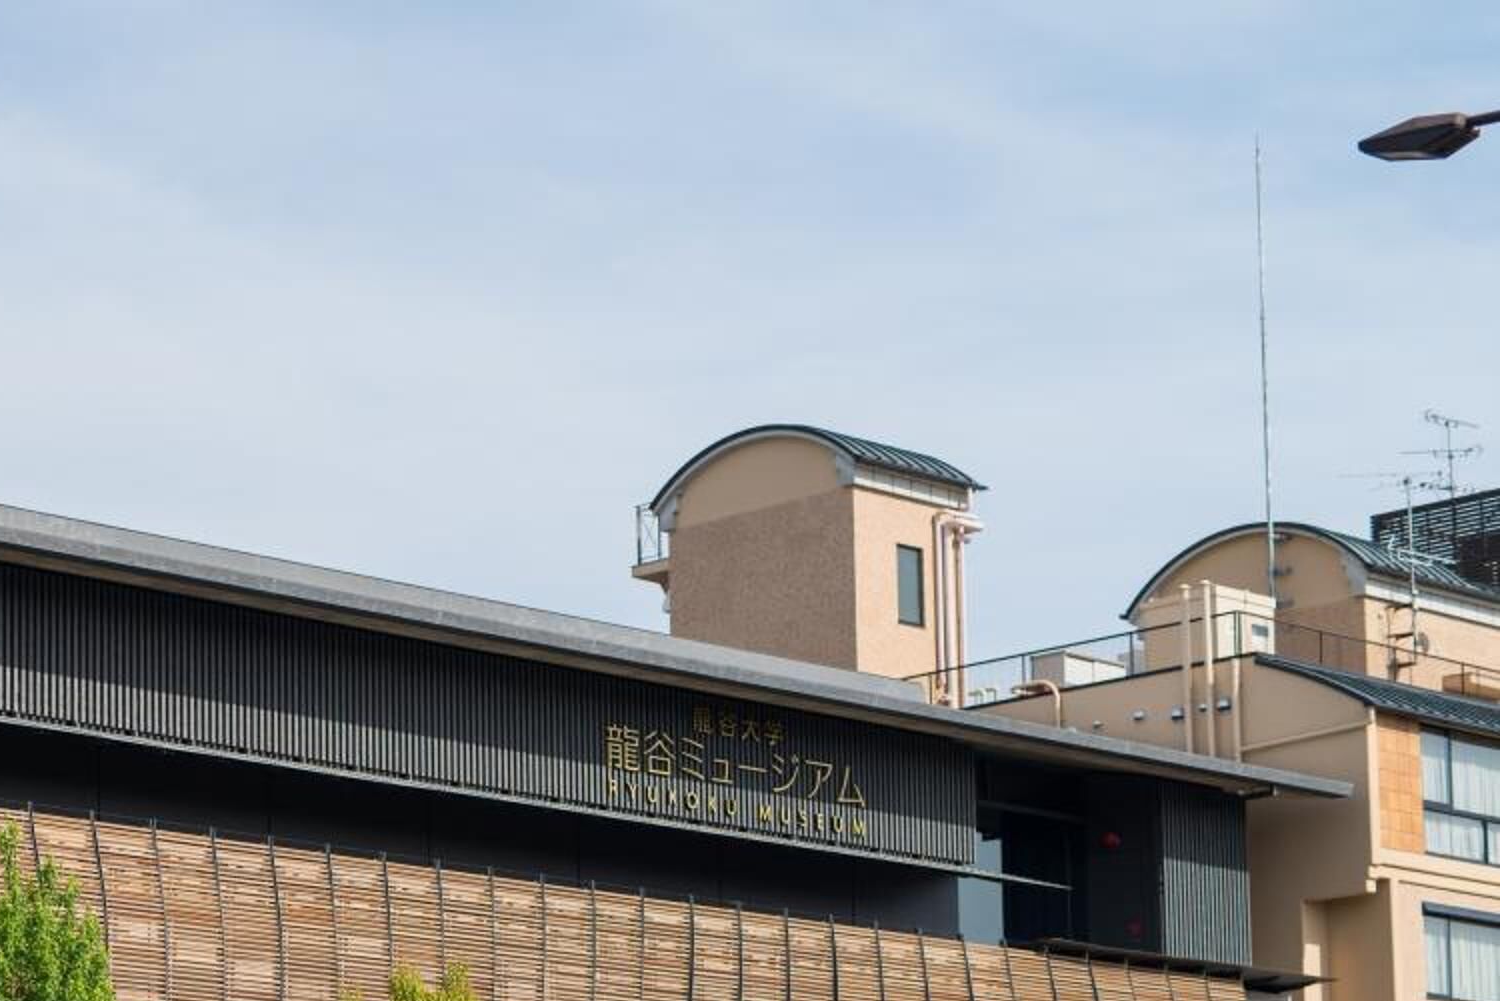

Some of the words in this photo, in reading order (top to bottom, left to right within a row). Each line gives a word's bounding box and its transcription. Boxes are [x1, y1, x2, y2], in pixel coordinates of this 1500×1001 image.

[606, 722, 866, 807] 龍谷ミュージアム
[608, 780, 739, 815] RYUKOKU
[758, 805, 868, 837] MUSEUM
